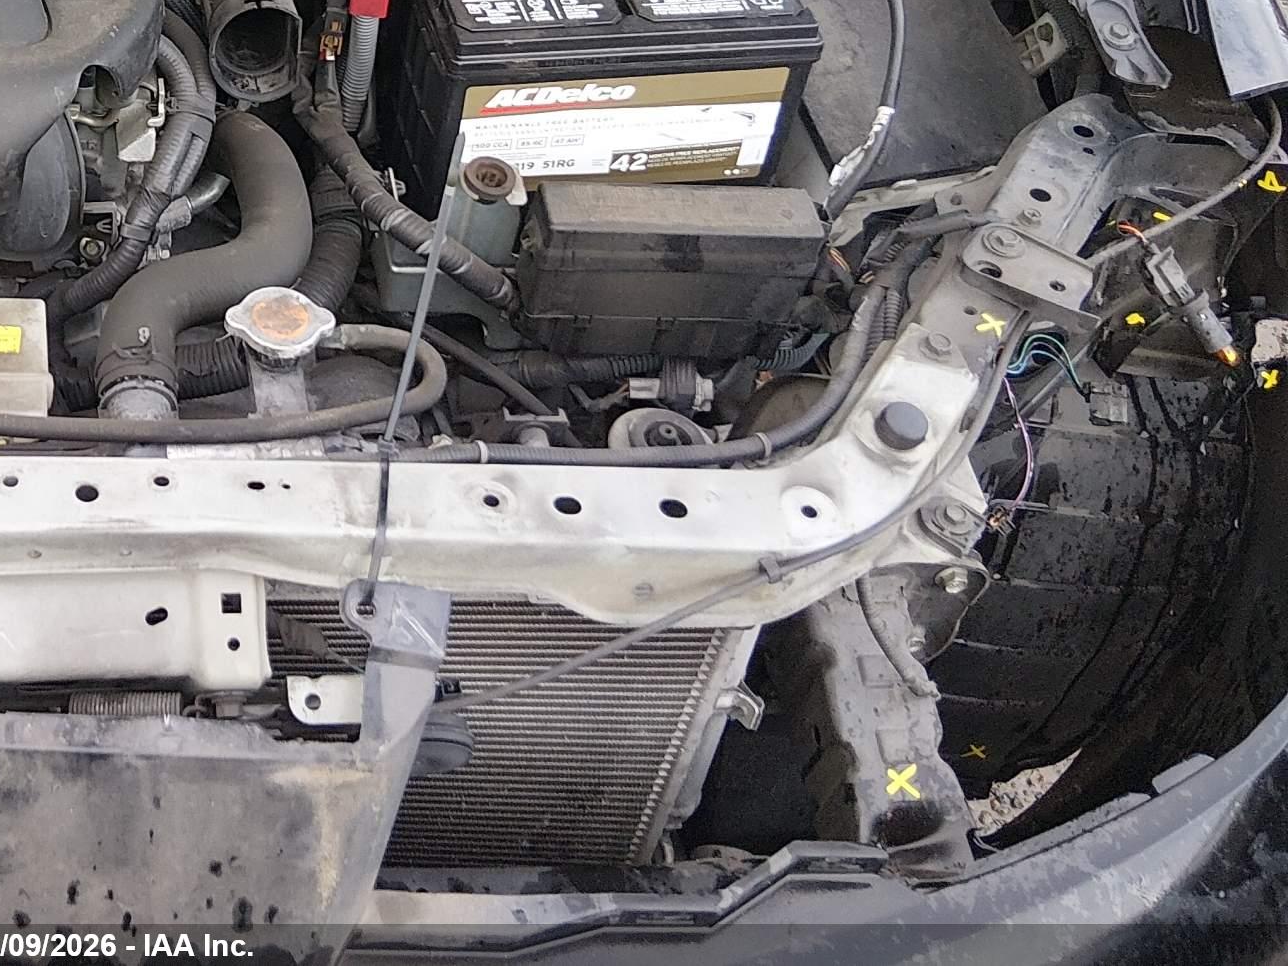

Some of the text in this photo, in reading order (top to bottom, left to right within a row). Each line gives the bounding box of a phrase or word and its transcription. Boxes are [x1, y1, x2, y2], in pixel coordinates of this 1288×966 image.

[485, 83, 636, 108] ACDelco
[543, 158, 577, 170] 51RG
[610, 152, 649, 173] 42
